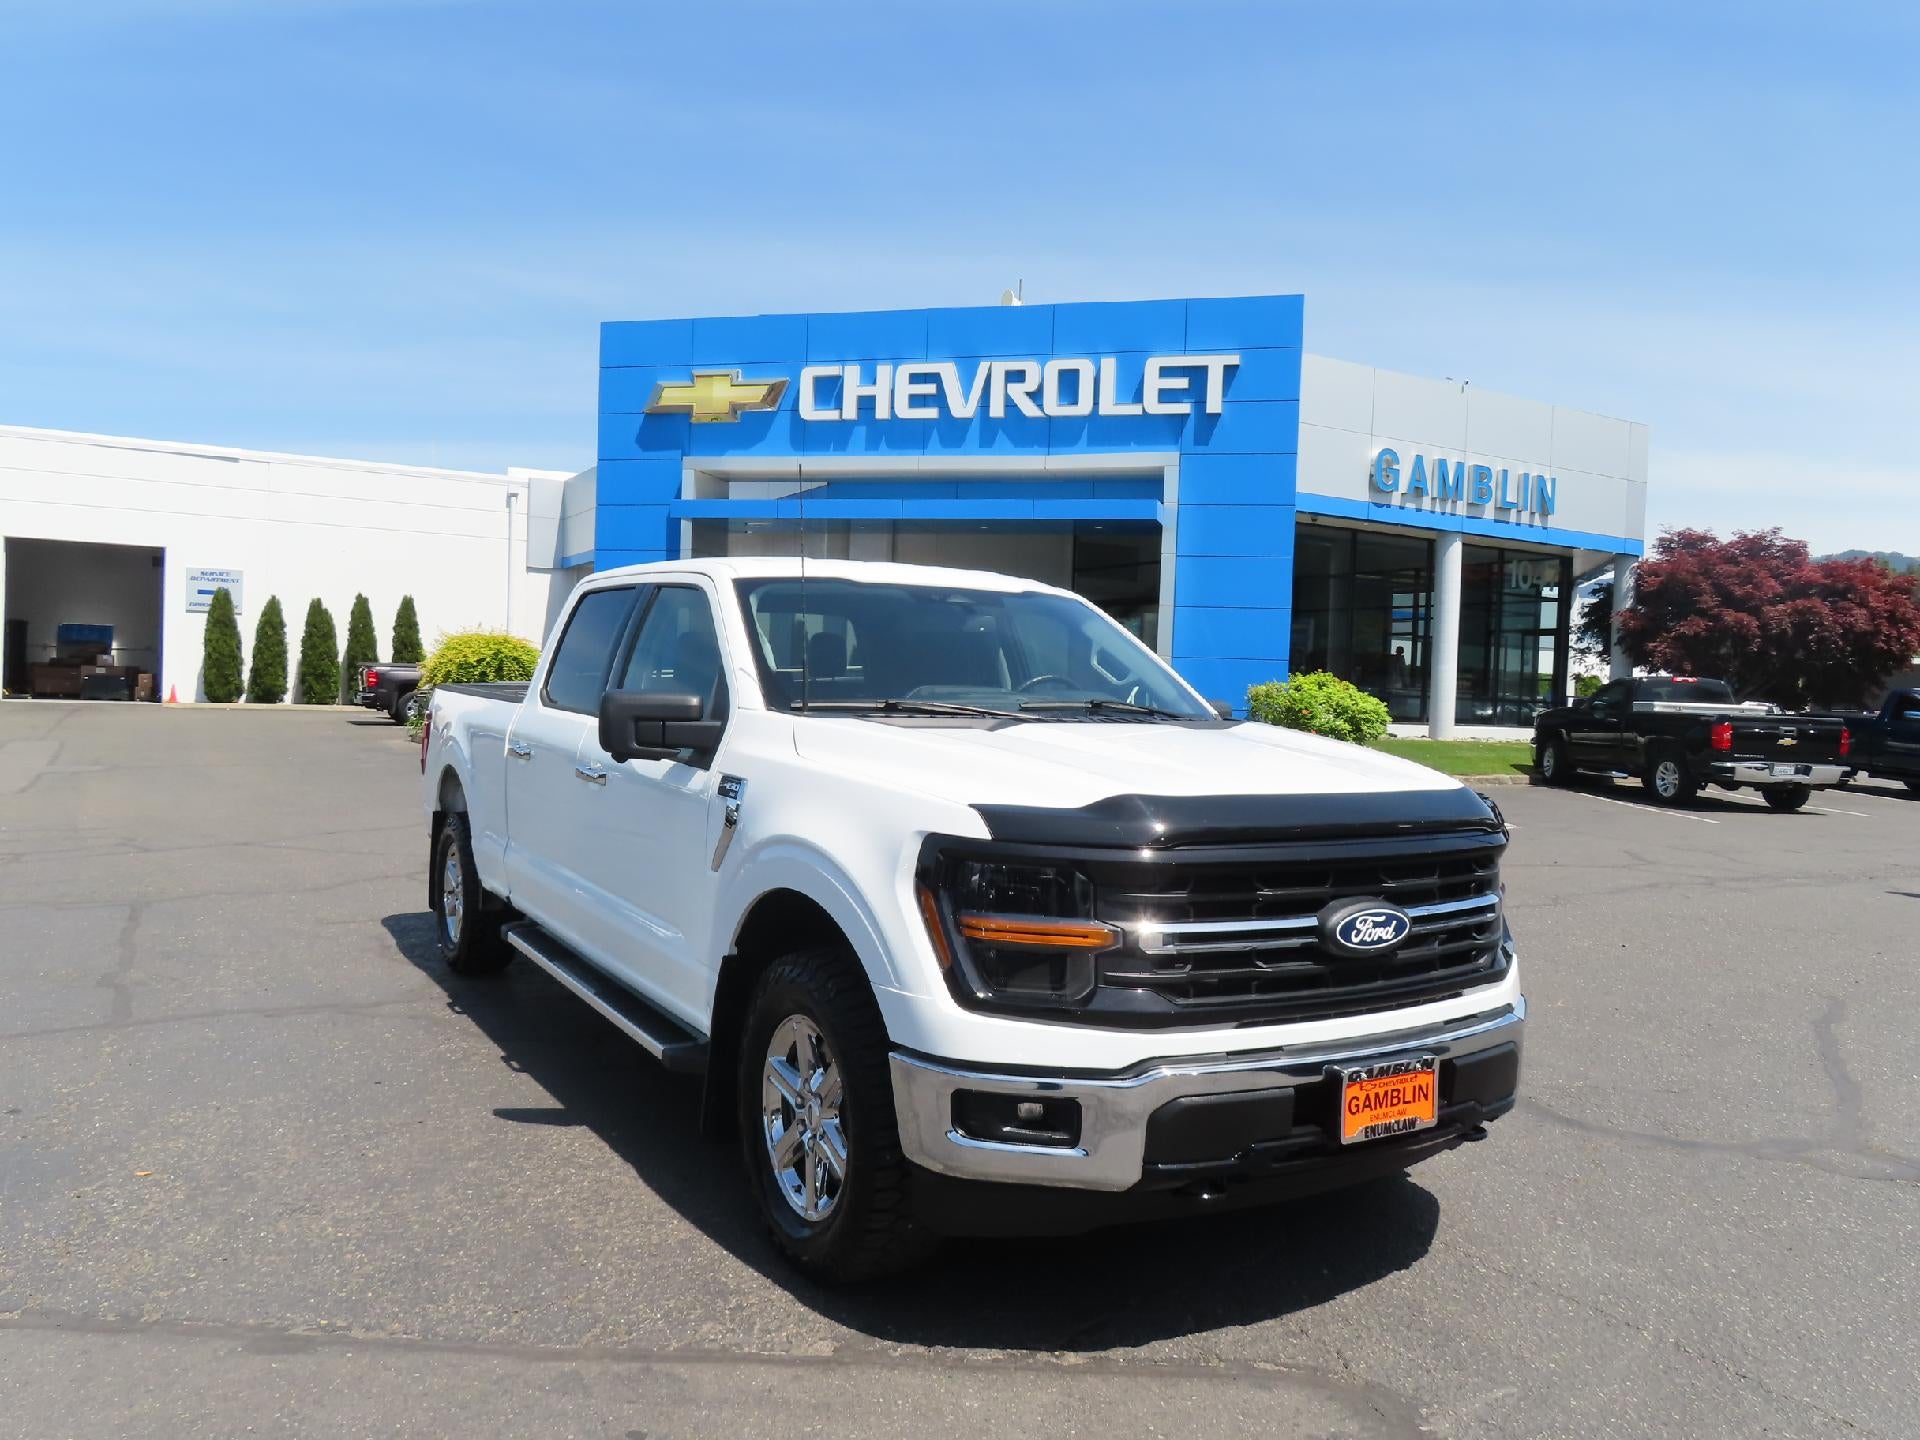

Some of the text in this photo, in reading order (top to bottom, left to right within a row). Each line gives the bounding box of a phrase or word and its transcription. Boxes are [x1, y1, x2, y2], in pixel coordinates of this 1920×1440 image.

[799, 354, 1241, 421] CHEVROLET
[1371, 447, 1557, 516] GAMBLIN
[1351, 915, 1397, 943] Ford
[1378, 1075, 1418, 1088] CHEVROLET
[1347, 1082, 1429, 1116] GAMBLIN
[1364, 1116, 1418, 1139] ENUMCLAW
[1369, 1108, 1408, 1122] ENUMCLAW
